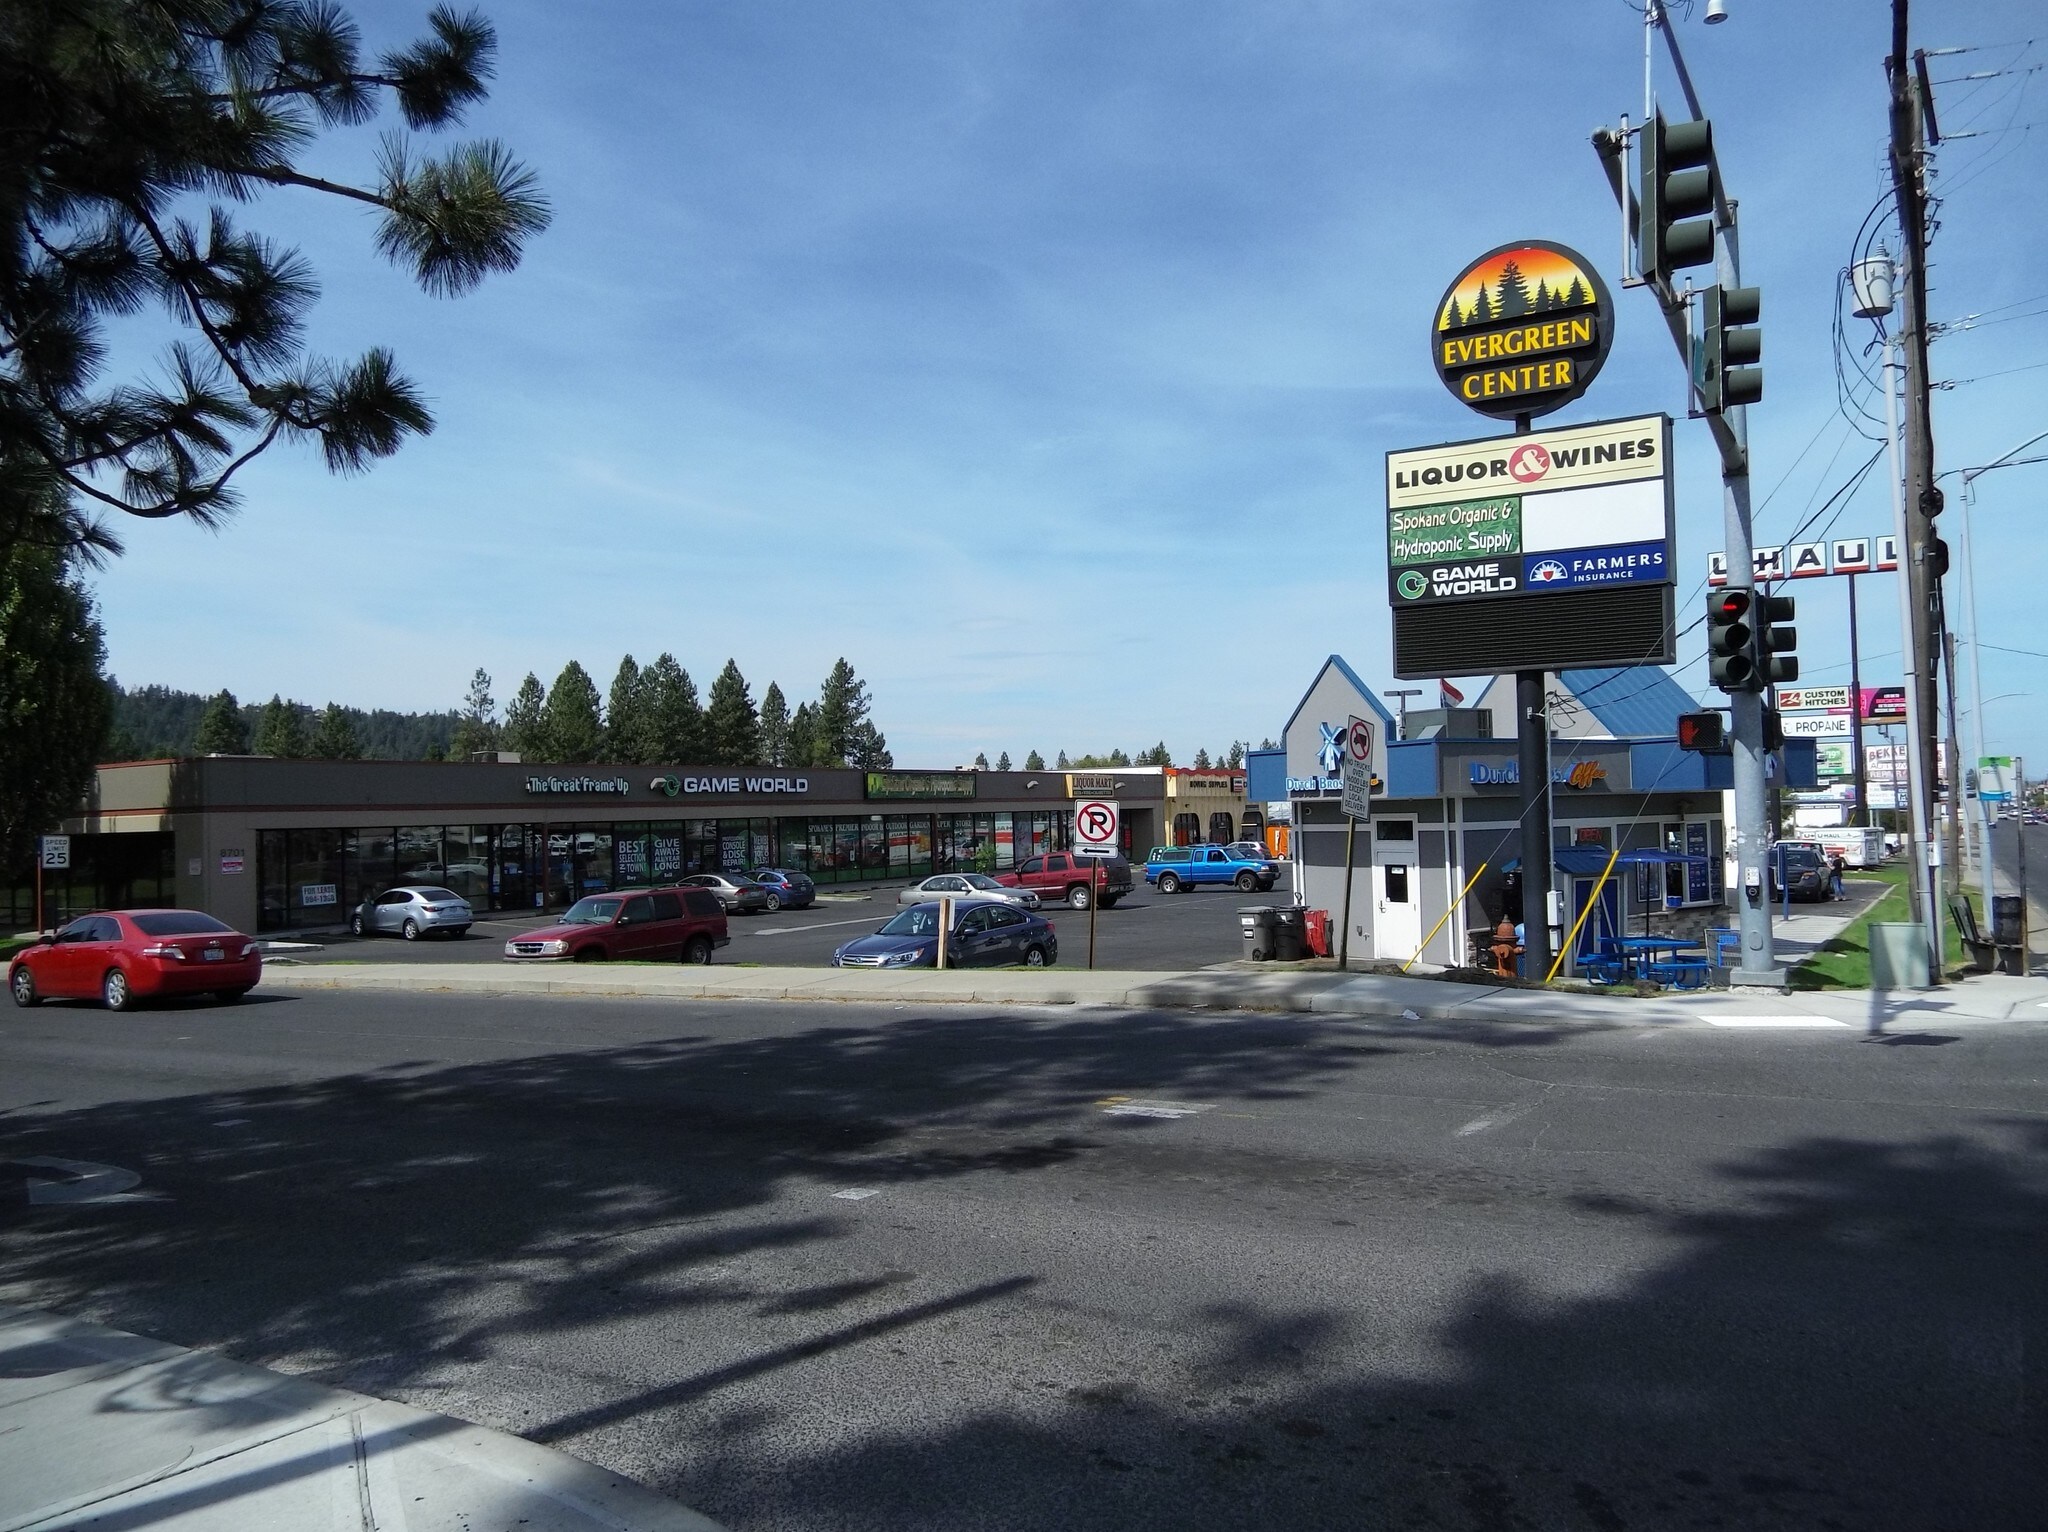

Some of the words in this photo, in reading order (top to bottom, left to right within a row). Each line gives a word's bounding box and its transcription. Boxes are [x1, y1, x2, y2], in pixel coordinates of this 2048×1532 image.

[1443, 317, 1590, 365] EVERGREEN
[1462, 360, 1571, 399] CENTER
[1395, 458, 1508, 489] LIQUOR
[1551, 438, 1656, 470] WINES
[1392, 512, 1447, 534] Spokane
[1449, 505, 1498, 528] Organic
[1501, 501, 1512, 519] &
[1393, 535, 1464, 561] Hydroponic
[1467, 528, 1513, 553] Supply
[1573, 552, 1663, 572] FARMERS
[1432, 563, 1500, 582] GAME
[1574, 570, 1634, 582] INSURANCE
[1433, 577, 1517, 597] WORLD
[1804, 690, 1845, 699] CUSTOM
[1805, 698, 1846, 706] HITCHES
[1796, 720, 1846, 733] PROPANE
[1354, 759, 1371, 772] TRUCKS
[530, 777, 548, 792] The
[549, 777, 580, 792] Great
[582, 777, 615, 792] Frame
[617, 778, 629, 795] Up
[683, 777, 740, 793] GAME
[745, 777, 809, 793] WORLD
[1073, 778, 1095, 790] LIQUOR
[1096, 778, 1112, 788] MART
[1348, 784, 1366, 795] EXCEPT
[1348, 792, 1364, 804] LOCAL
[1344, 800, 1366, 812] DELIVERY
[835, 824, 858, 832] PREMIER
[618, 840, 646, 854] BEST
[654, 838, 680, 848] GIVE
[722, 840, 746, 850] CONSOLE
[46, 852, 66, 864] 25
[618, 854, 646, 862] SELECTION
[654, 848, 680, 856] AWAYS
[728, 850, 746, 859] DISC
[654, 862, 680, 870] LONG!
[722, 859, 746, 867] REPAIR!
